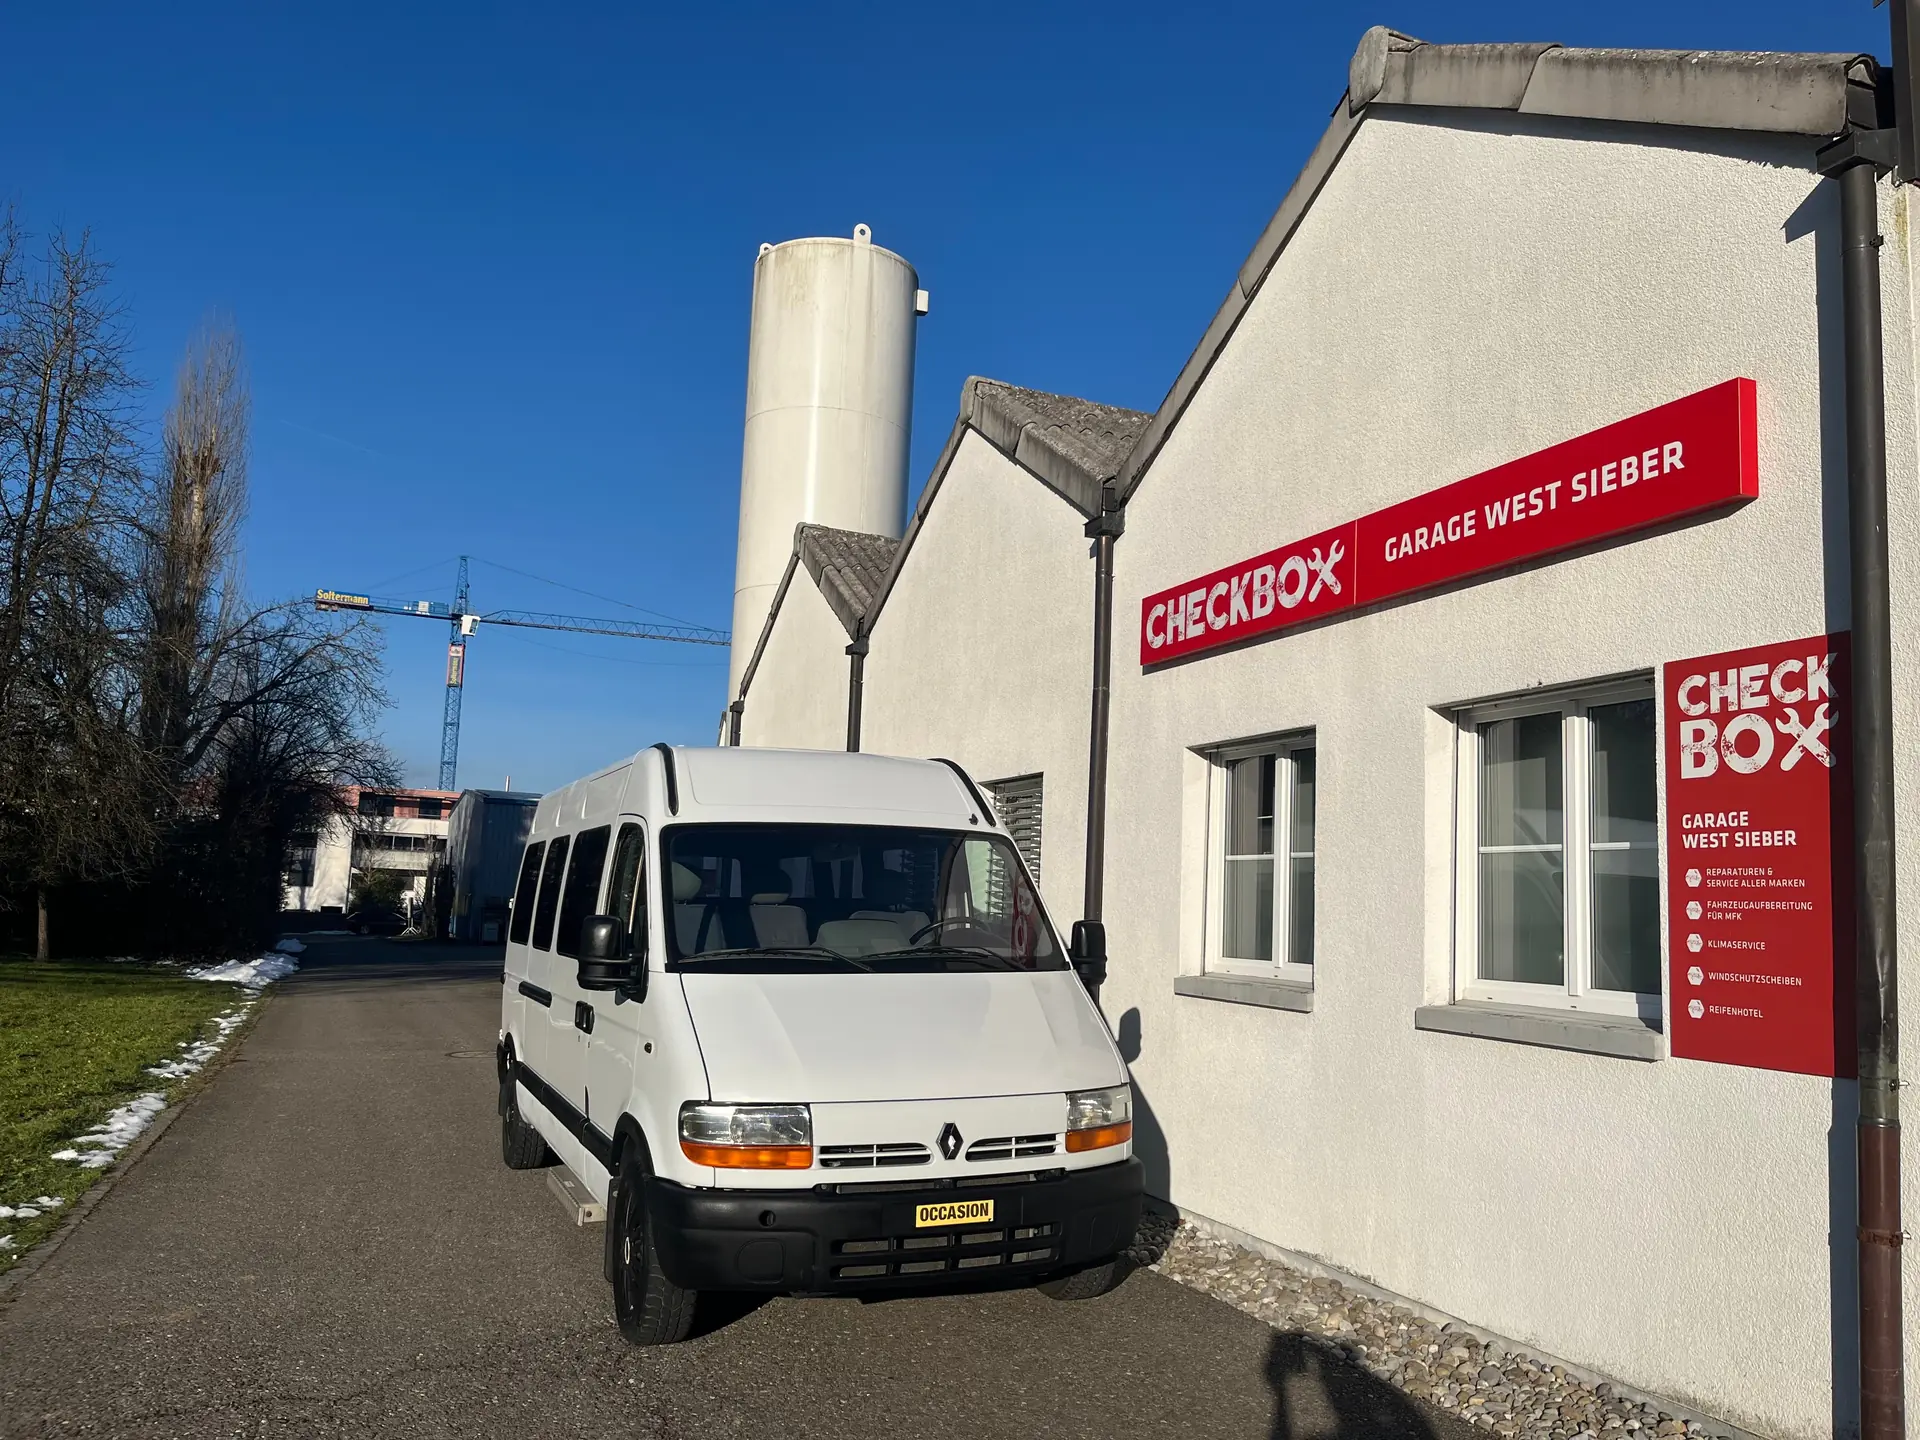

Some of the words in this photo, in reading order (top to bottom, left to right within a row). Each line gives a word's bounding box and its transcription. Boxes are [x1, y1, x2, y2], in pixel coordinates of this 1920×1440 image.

[1385, 510, 1476, 562] GARAGE
[1484, 481, 1562, 529] WEST
[1571, 441, 1685, 502] SIEBER
[1677, 653, 1839, 717] CHECK
[1682, 811, 1749, 829] GARAGE
[1682, 832, 1729, 849] WEST
[1734, 830, 1797, 847] SIEBER
[1706, 867, 1765, 876] REPARATUREN
[1767, 867, 1773, 876] &
[1706, 879, 1739, 888] SERVICE
[1741, 879, 1767, 888] ALLER
[1769, 879, 1806, 888] MARKEN
[1707, 900, 1813, 911] FAHRZEUGAUFBEREITUNG
[1707, 911, 1723, 921] FÜR
[1725, 912, 1742, 921] MFK
[1707, 939, 1766, 950] KLIMASERVICE
[1708, 972, 1802, 986] WINDSCHUTZSCHEIBEN
[1709, 1005, 1763, 1018] REIFENHOTEL
[920, 1202, 989, 1221] OCCASION
